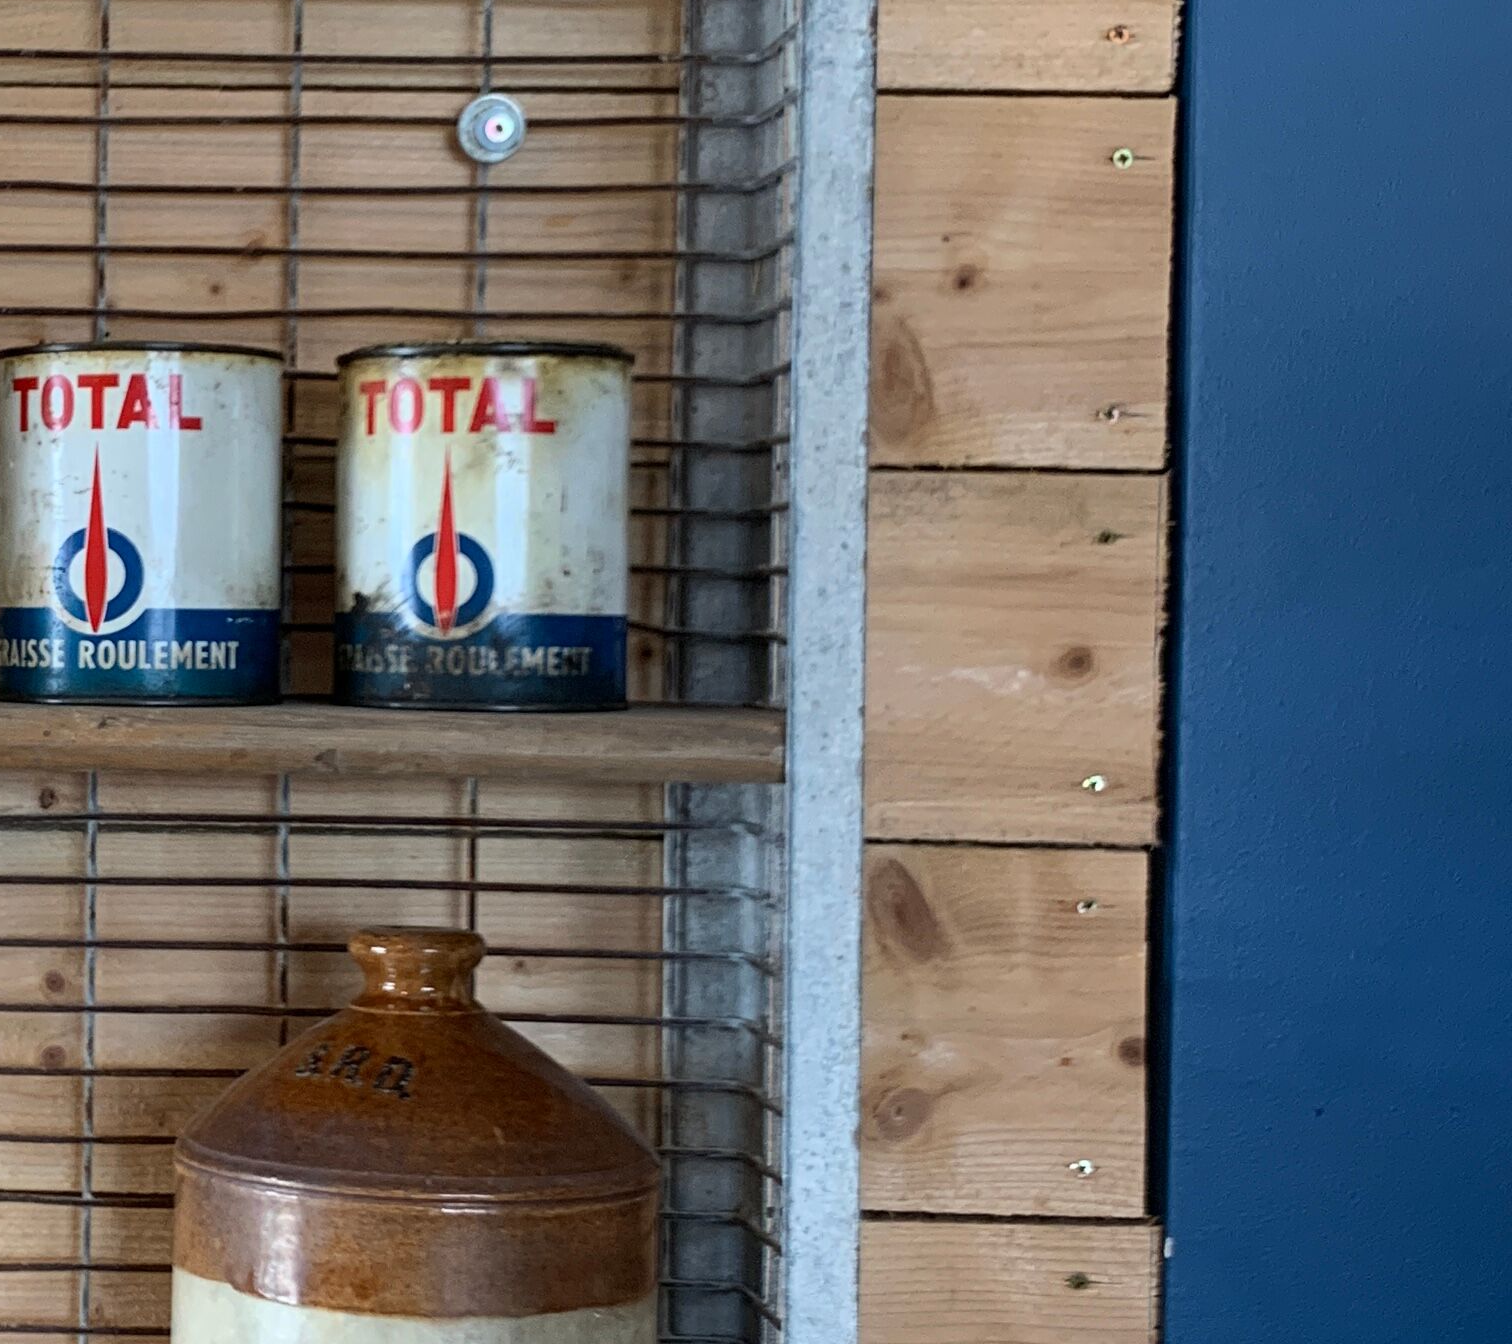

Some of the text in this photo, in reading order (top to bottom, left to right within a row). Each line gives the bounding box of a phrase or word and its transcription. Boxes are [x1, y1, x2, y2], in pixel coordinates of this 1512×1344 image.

[13, 373, 203, 433] TOTAL
[360, 376, 558, 436] TOTAL
[77, 639, 240, 671] ROULEMENT
